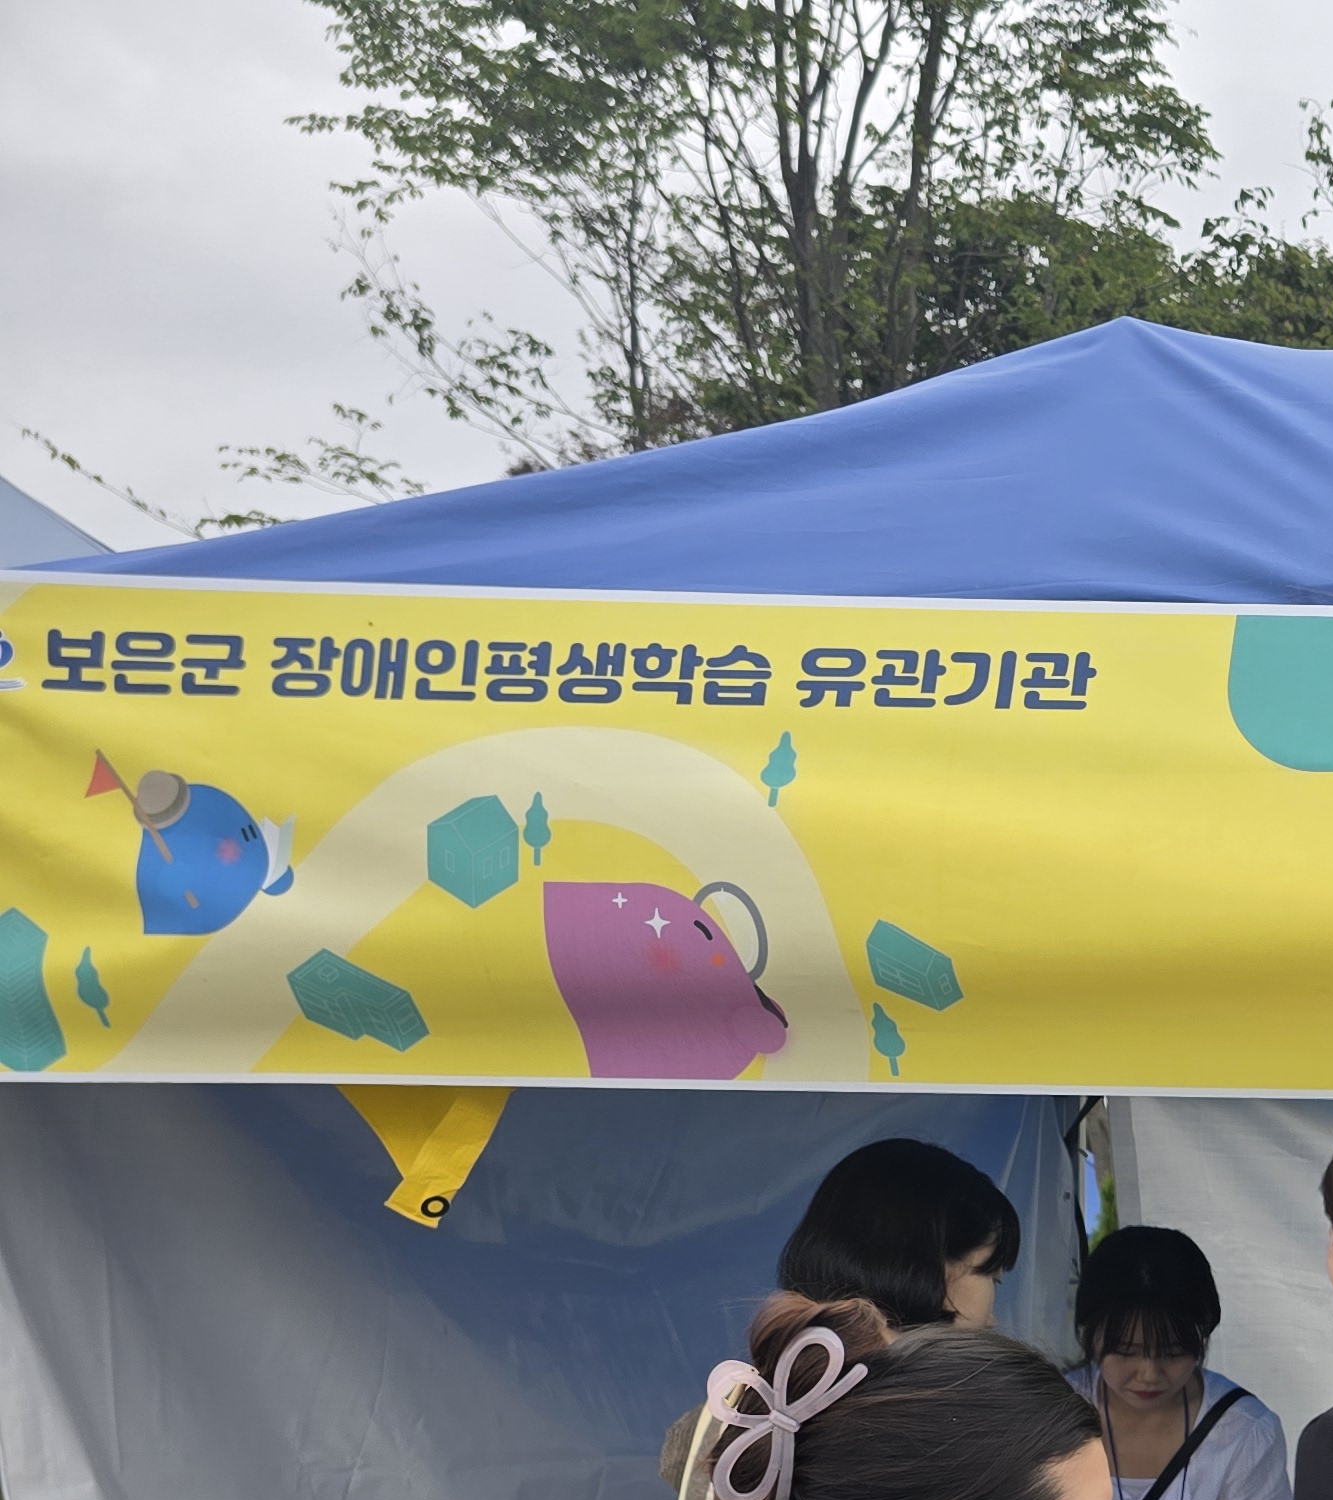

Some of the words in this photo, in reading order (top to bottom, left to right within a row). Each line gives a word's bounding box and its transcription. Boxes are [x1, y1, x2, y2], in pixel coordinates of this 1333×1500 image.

[42, 629, 246, 697] 보은군
[270, 635, 773, 707] 장애인평생학습
[796, 647, 1098, 712] 유관기관
